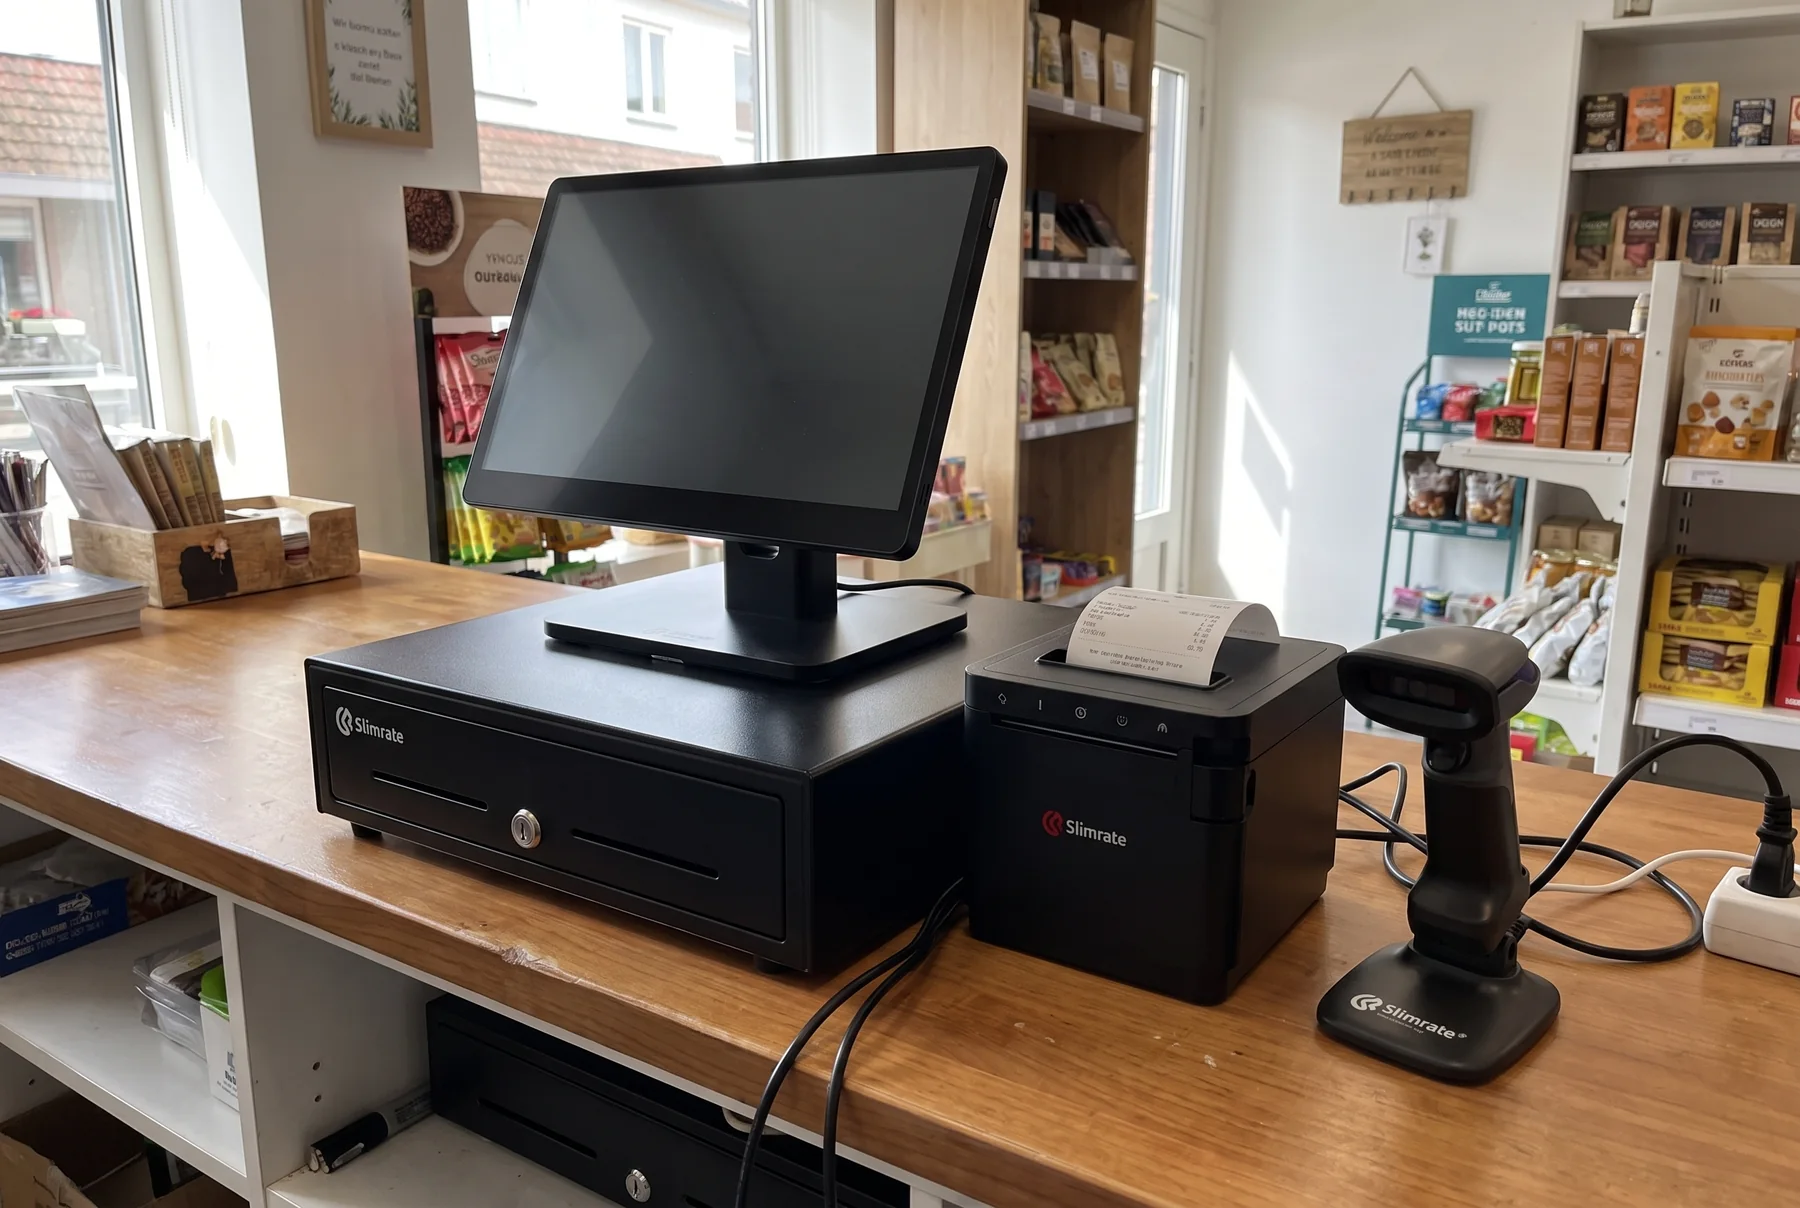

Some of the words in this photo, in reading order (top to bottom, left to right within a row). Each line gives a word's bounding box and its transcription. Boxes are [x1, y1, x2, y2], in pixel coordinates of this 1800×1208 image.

[355, 716, 404, 744] Slimrate
[1065, 819, 1127, 847] Slimrate
[1381, 1003, 1456, 1039] Slimrate
